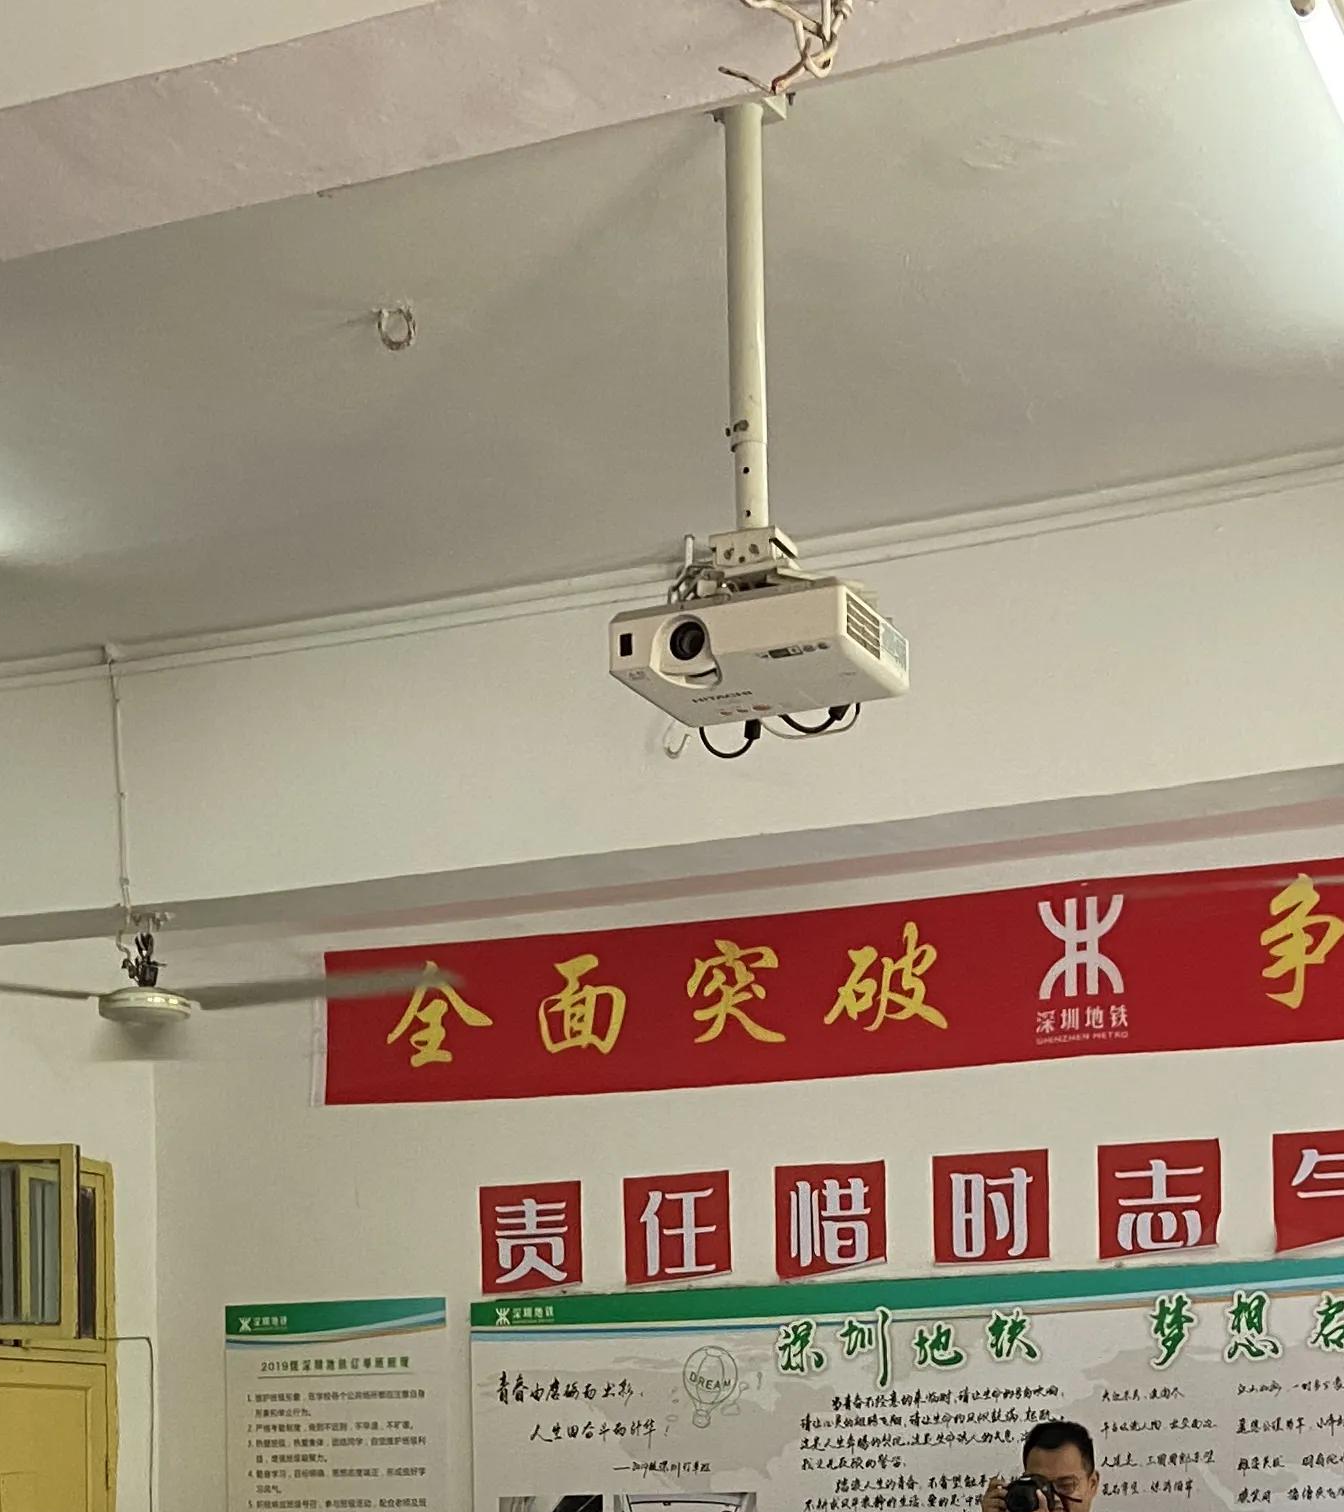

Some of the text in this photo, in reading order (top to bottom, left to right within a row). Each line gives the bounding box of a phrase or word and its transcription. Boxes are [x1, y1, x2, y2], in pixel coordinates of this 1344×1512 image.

[386, 921, 948, 1067] 全面突破
[1036, 1005, 1128, 1033] 深圳地铁
[778, 1309, 1038, 1387] 深圳地铁
[689, 1371, 731, 1390] DREAM
